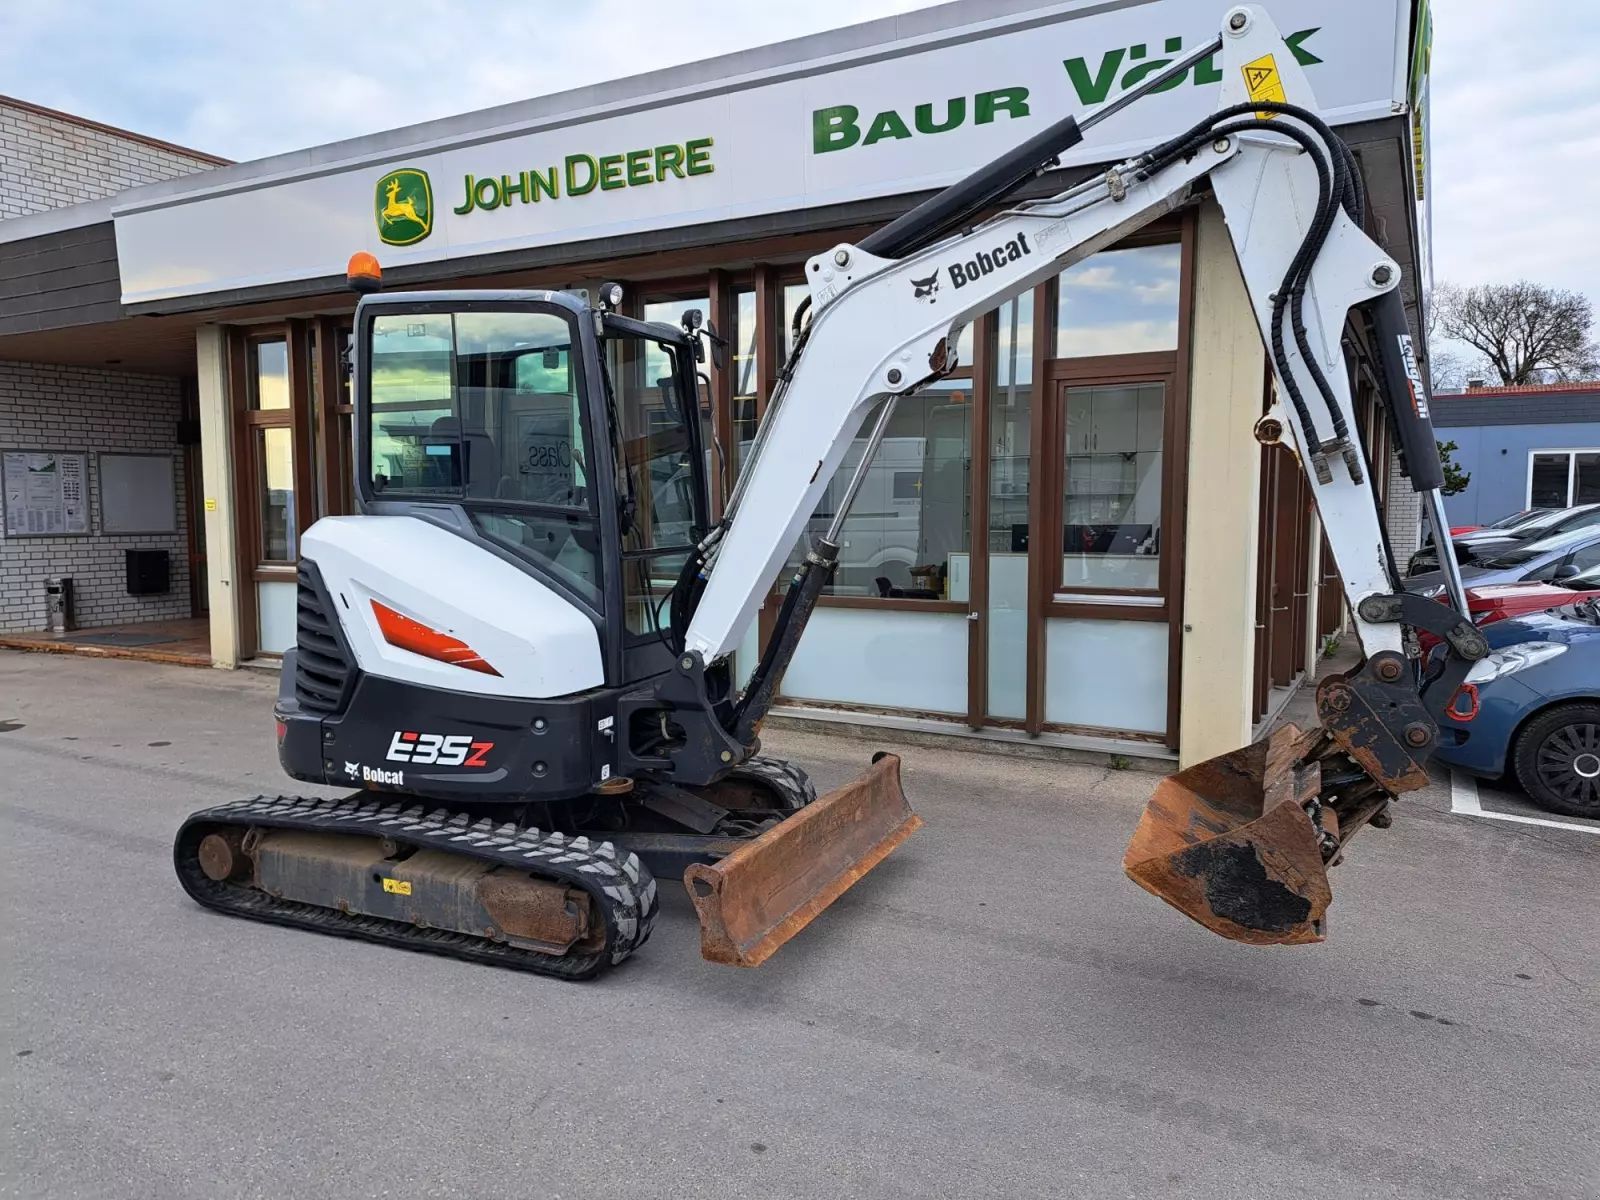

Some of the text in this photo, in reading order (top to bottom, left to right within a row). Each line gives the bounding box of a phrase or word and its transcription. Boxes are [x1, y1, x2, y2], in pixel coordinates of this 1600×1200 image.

[454, 137, 715, 215] JOHN DEERE
[947, 231, 1032, 290] Bobcat
[362, 765, 404, 785] Bobcat
